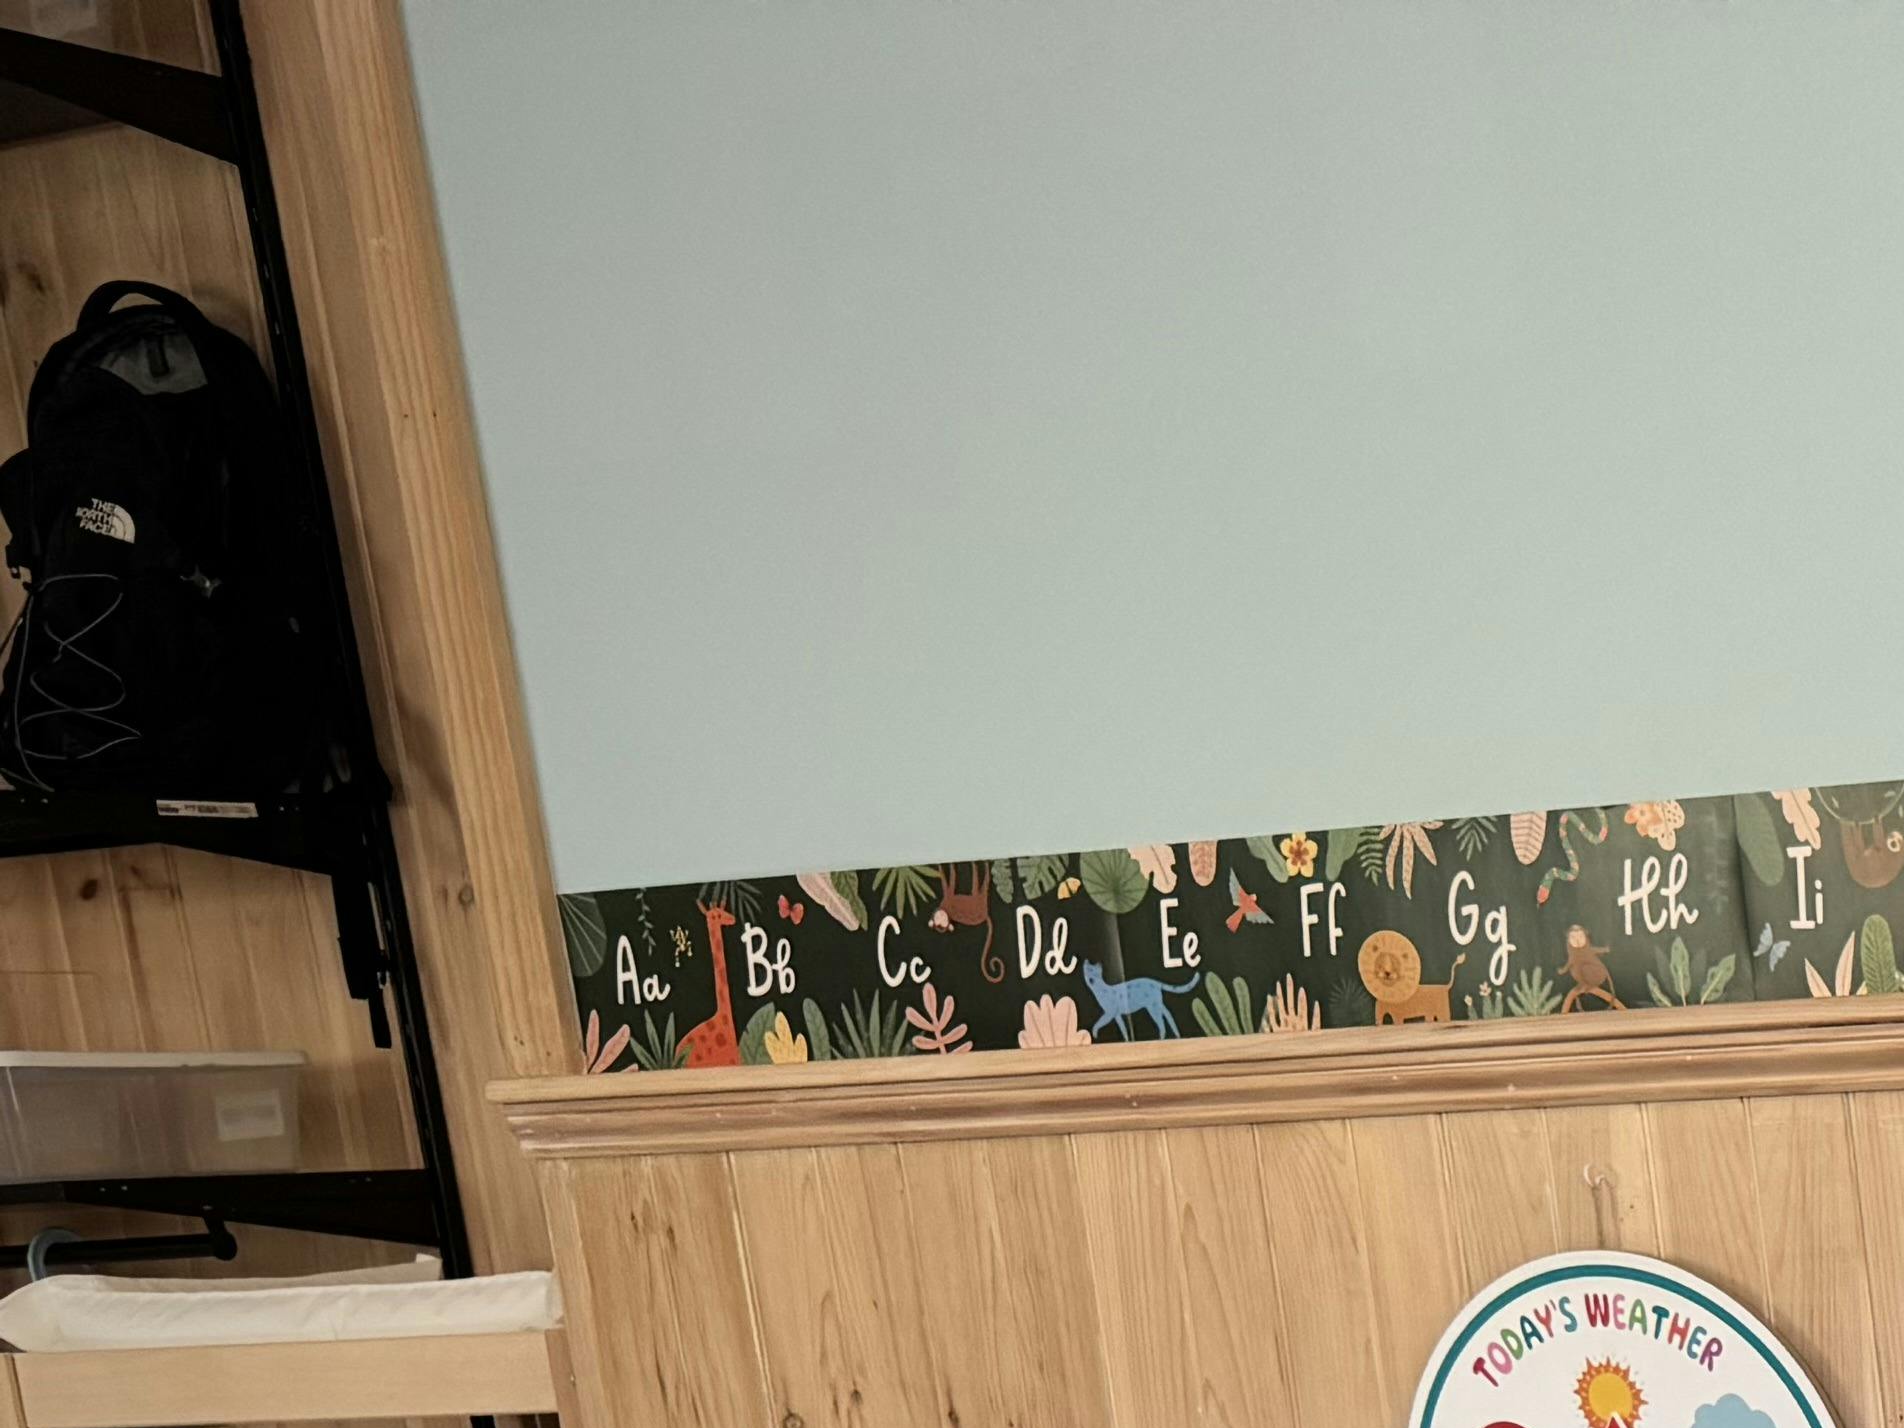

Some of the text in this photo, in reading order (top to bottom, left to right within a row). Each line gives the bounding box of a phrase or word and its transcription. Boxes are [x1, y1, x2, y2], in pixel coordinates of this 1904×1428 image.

[615, 934, 671, 1004] Aa
[742, 927, 796, 996] Bb
[877, 916, 930, 988] Cc
[1017, 905, 1077, 978] Dd
[1162, 899, 1200, 968] Ee
[1301, 882, 1346, 957] Ff
[1448, 870, 1515, 982] Gg
[1619, 853, 1698, 935] Hh
[1786, 845, 1825, 930] Ii
[1473, 1293, 1723, 1388] TODAY'S WEATHER
